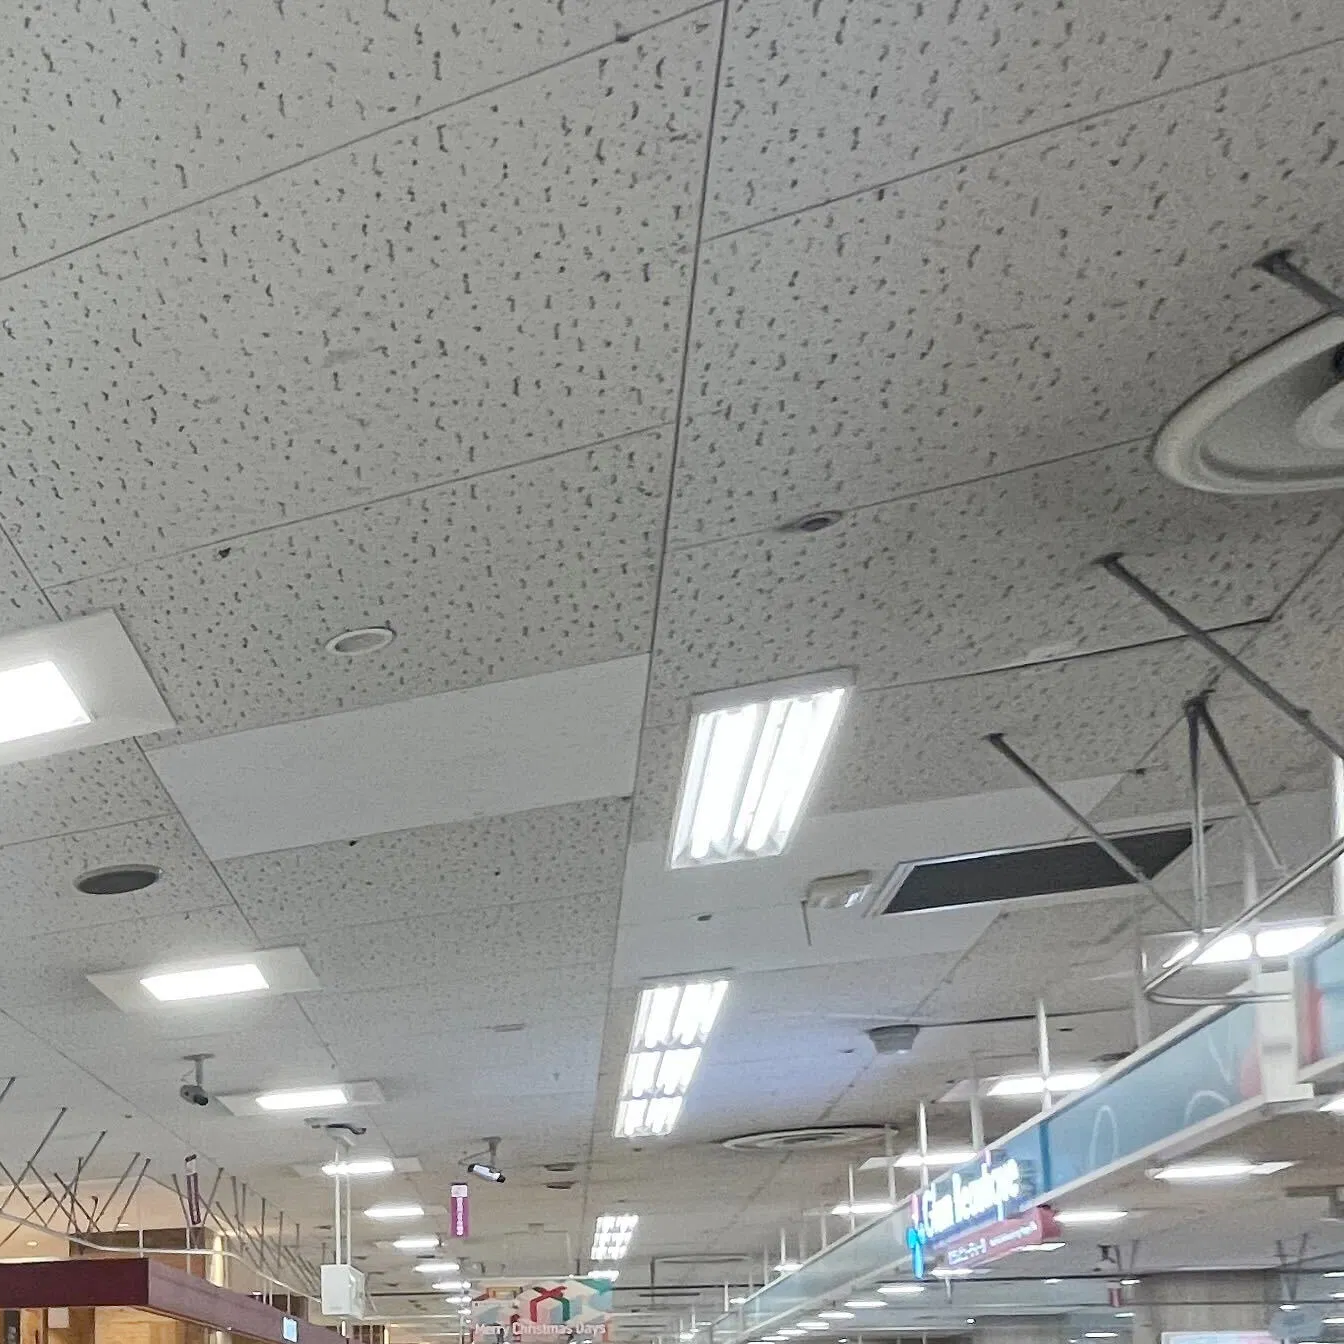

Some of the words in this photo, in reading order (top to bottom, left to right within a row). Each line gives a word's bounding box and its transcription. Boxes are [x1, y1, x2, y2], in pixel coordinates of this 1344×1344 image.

[475, 1323, 510, 1336] Merry
[512, 1321, 573, 1336] Christmas
[576, 1321, 606, 1337] Days
